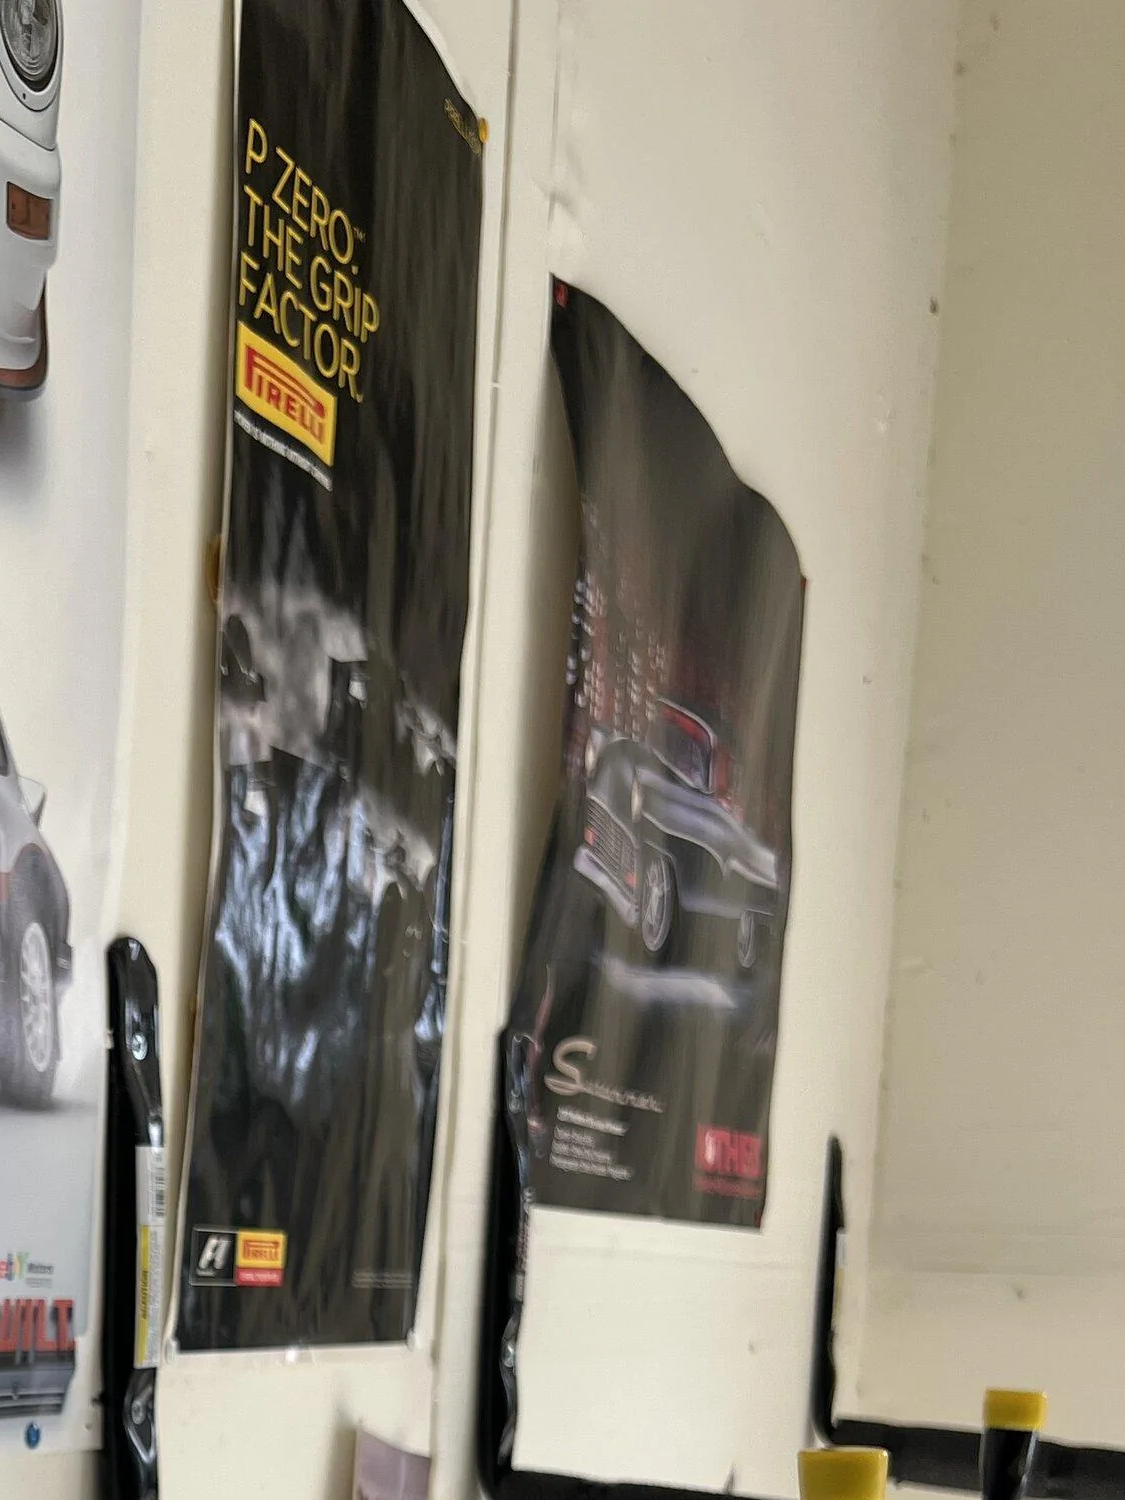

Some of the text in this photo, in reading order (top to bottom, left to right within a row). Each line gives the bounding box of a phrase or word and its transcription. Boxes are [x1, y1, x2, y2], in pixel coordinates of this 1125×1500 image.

[245, 117, 268, 174] P
[244, 184, 380, 343] THE GRIP
[245, 344, 326, 445] PIRELLI
